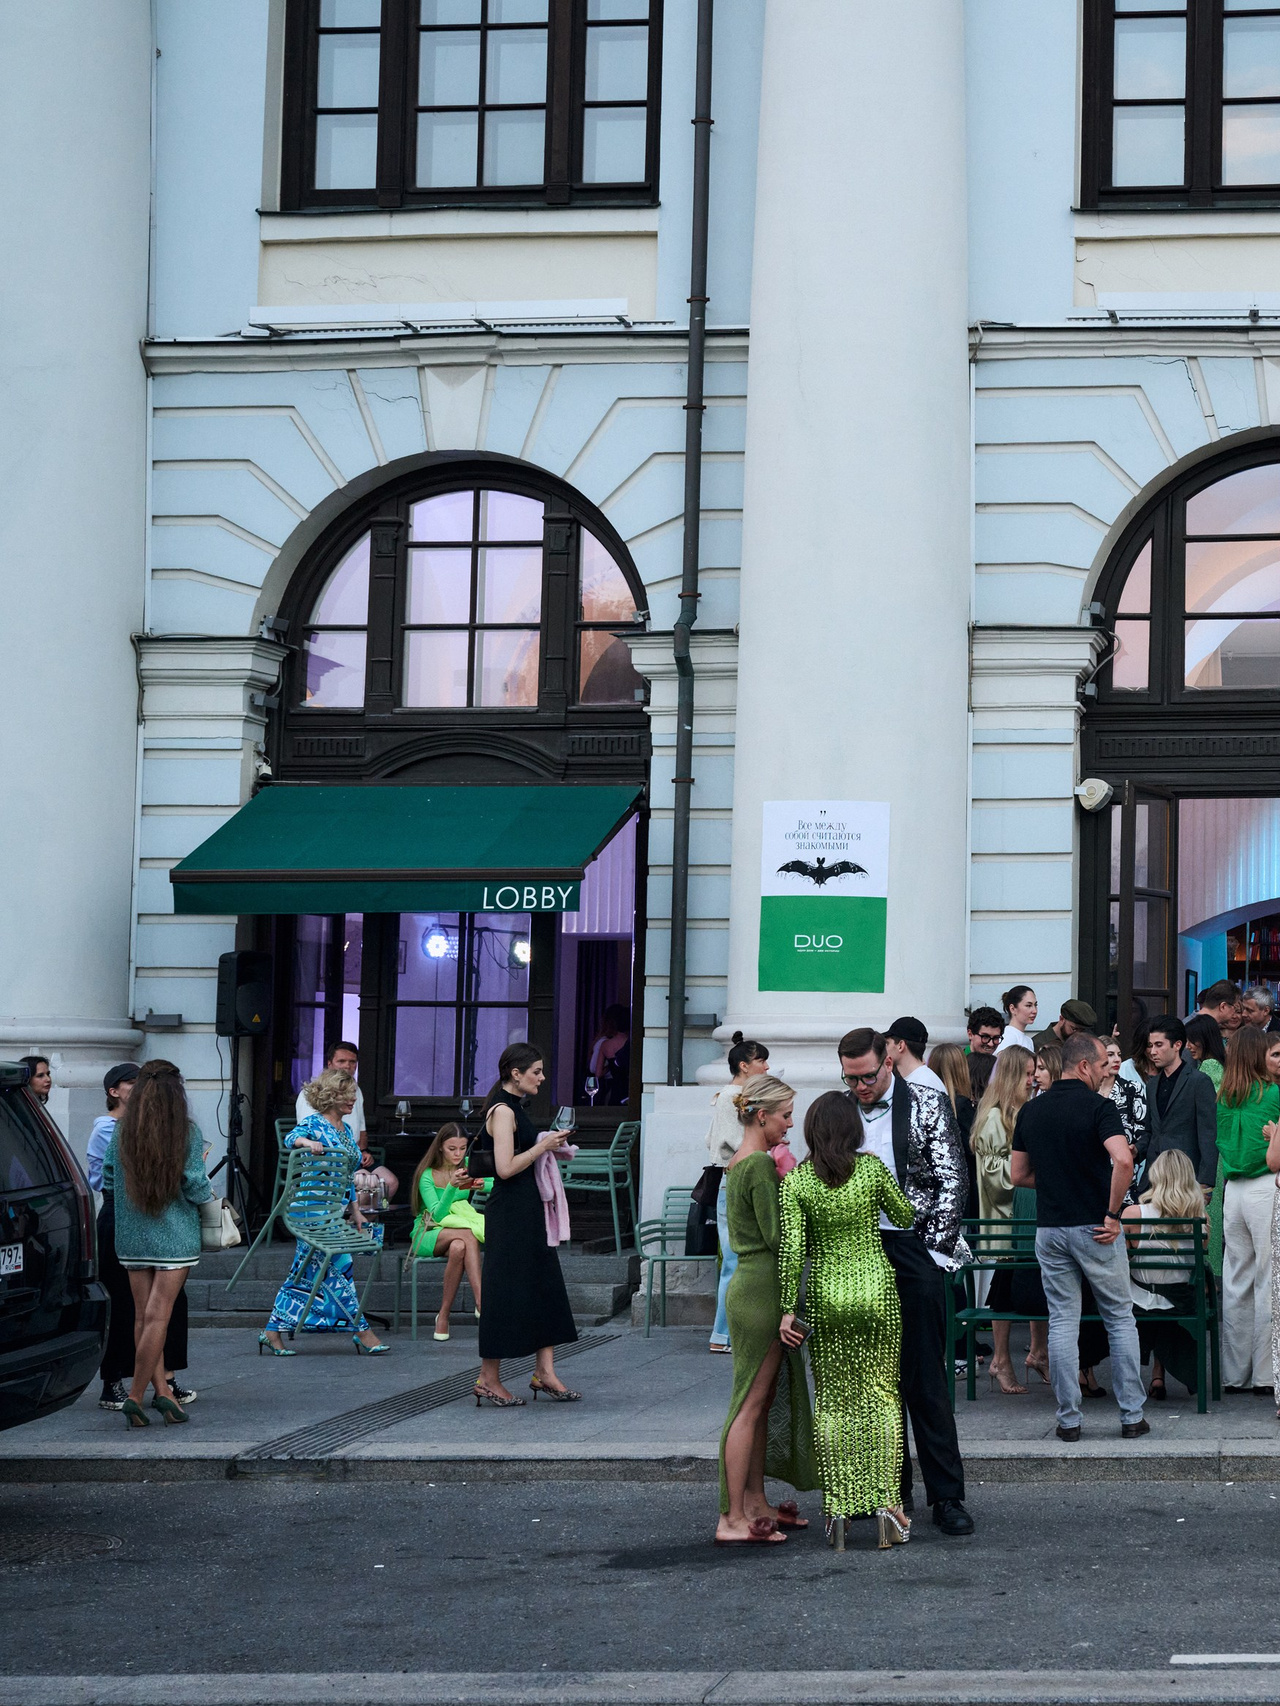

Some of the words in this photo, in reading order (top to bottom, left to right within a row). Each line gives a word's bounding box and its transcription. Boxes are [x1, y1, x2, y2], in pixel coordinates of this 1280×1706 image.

[797, 820, 812, 830] Все
[815, 822, 847, 832] между
[784, 830, 809, 840] собой
[812, 832, 861, 841] считаются
[795, 842, 849, 850] знакомыми
[483, 886, 573, 909] LOBBY
[794, 934, 843, 948] DUO
[1, 1246, 19, 1265] 797
